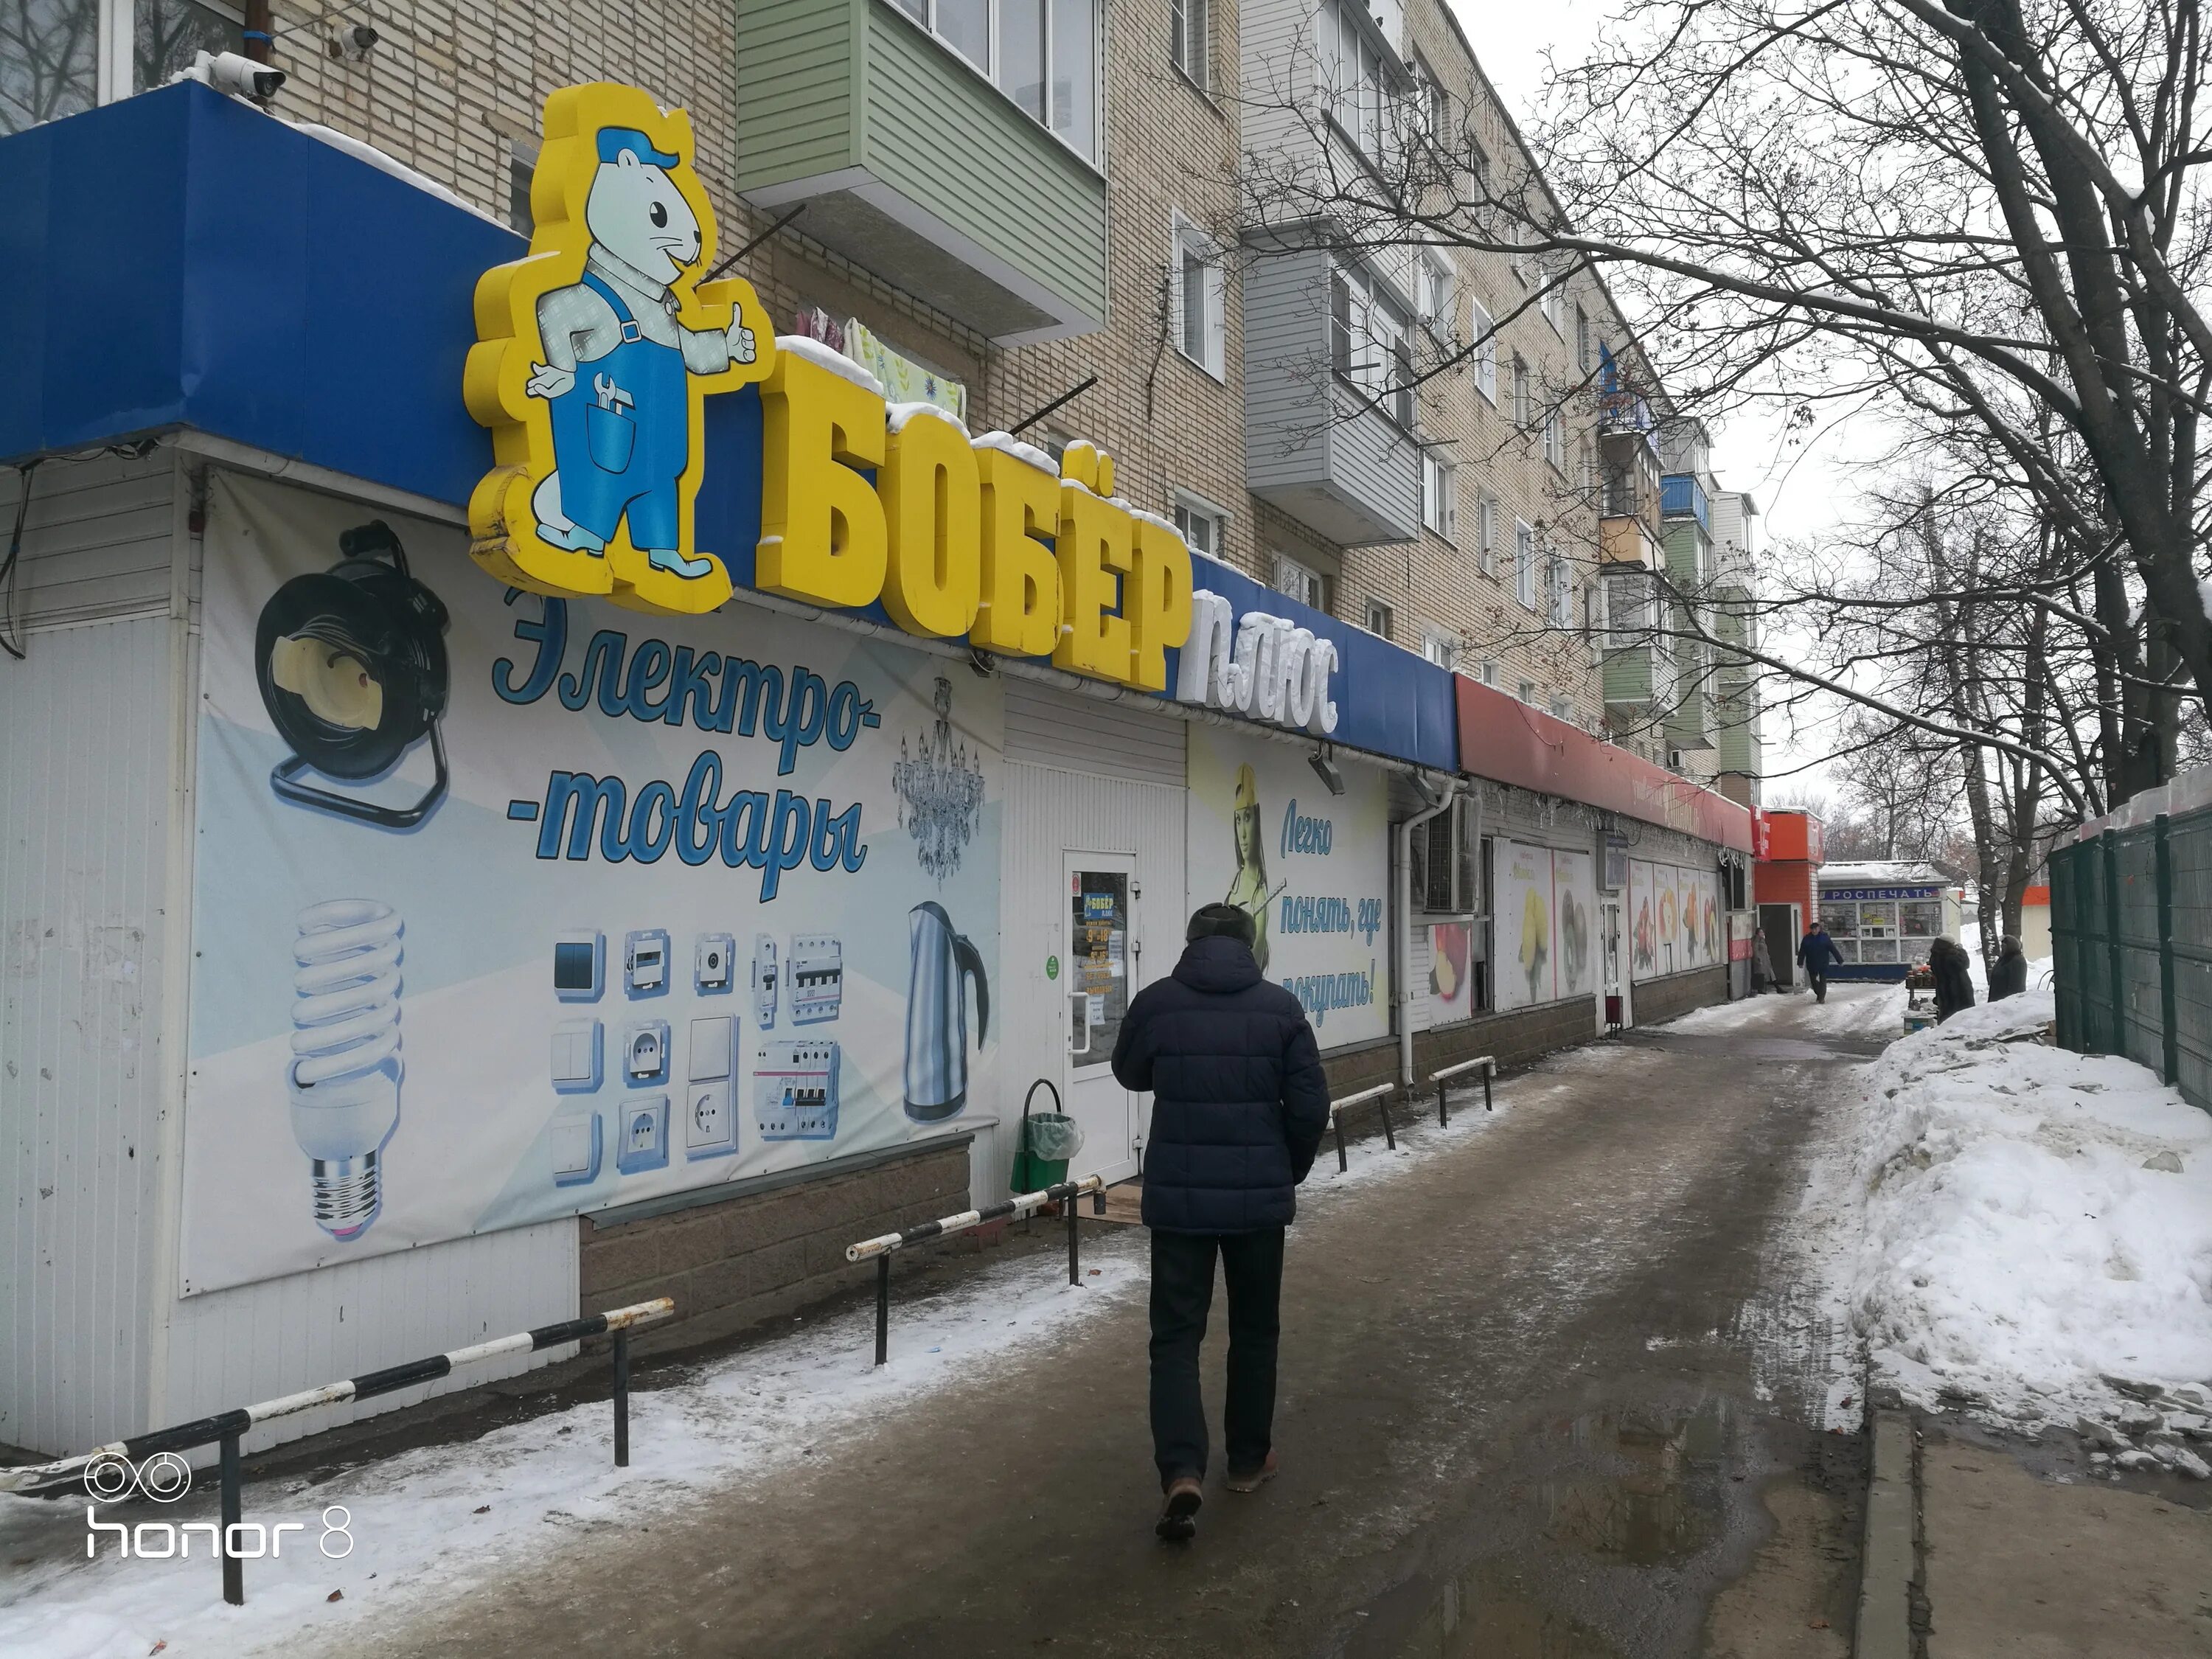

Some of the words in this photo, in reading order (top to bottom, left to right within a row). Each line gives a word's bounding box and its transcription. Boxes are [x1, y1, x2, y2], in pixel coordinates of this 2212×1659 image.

[757, 349, 1193, 692] БОБЁР
[492, 586, 881, 776] Электро-
[507, 750, 868, 903] -товары
[1281, 799, 1332, 858] Легко
[1281, 896, 1354, 939] понять,
[1357, 897, 1382, 946] где
[1832, 889, 1933, 900] РОСПЕЧАТЬ
